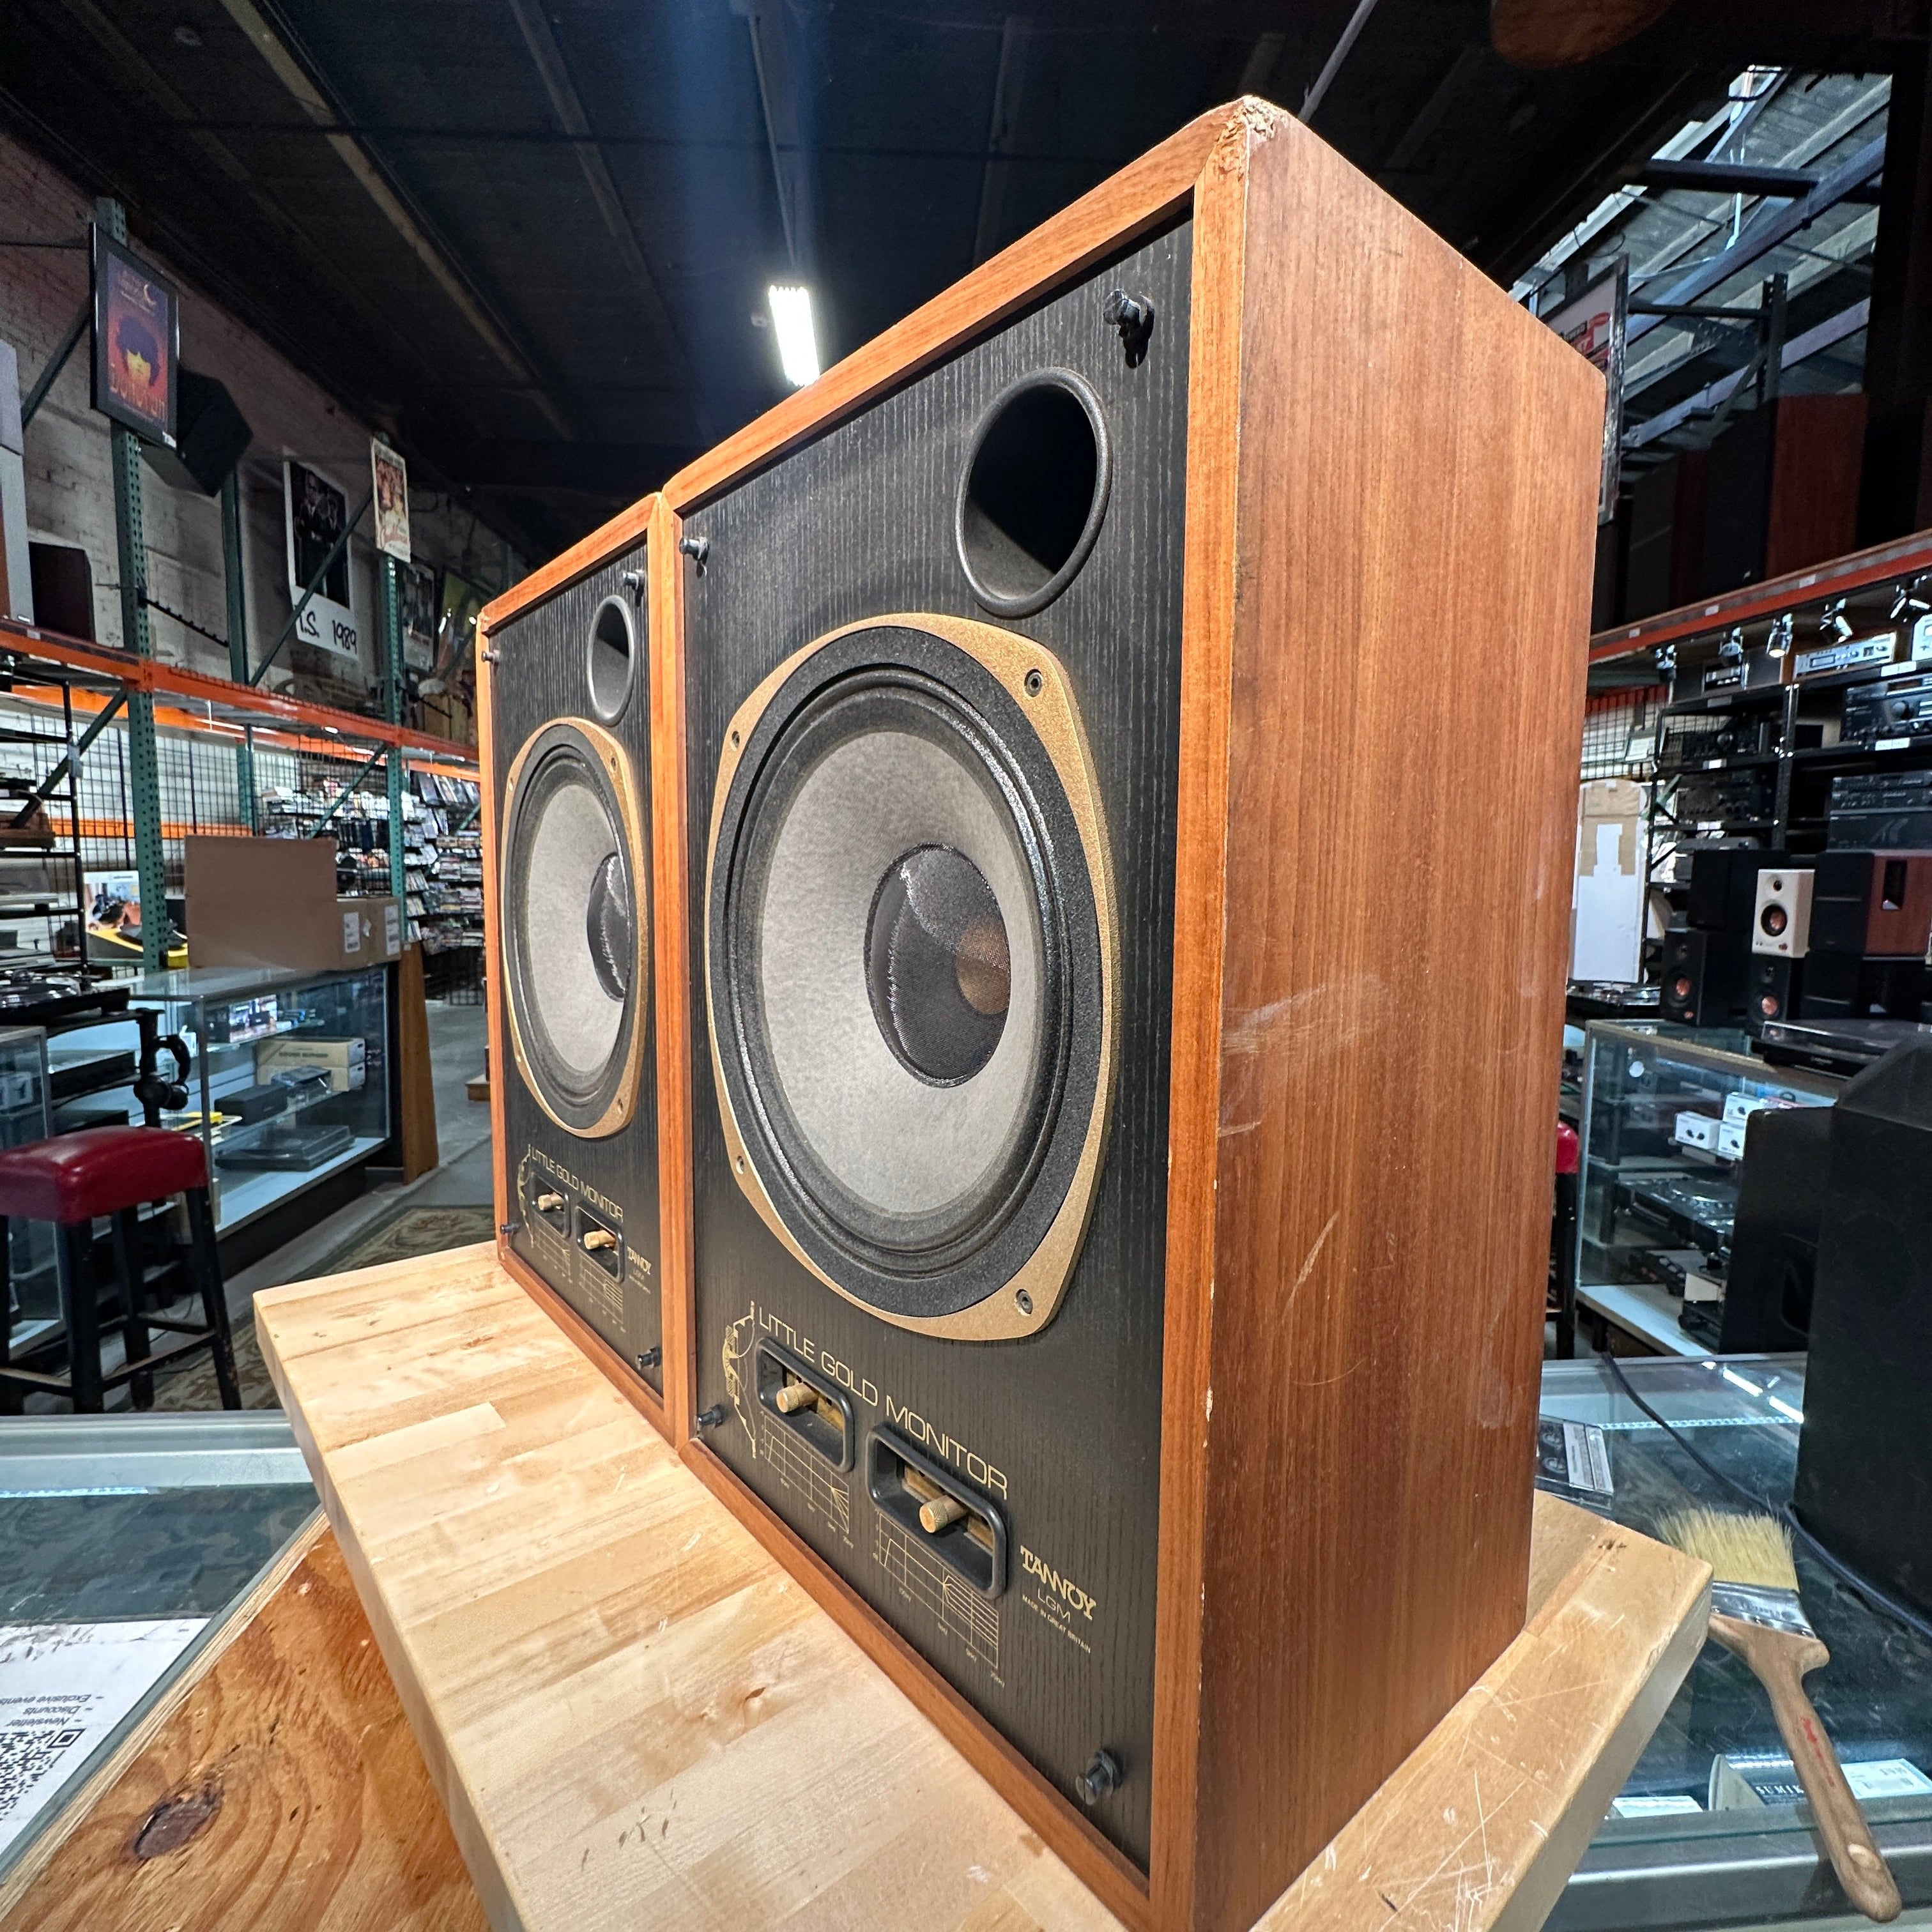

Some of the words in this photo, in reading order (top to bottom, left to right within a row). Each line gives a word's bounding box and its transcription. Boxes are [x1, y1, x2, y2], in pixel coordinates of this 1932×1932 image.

[332, 620, 356, 654] 1989
[532, 1147, 555, 1174] LITTLE
[556, 1165, 579, 1190] GOLD
[580, 1181, 624, 1223] MONITOR
[758, 1306, 815, 1363] LITTLE
[821, 1351, 878, 1407] GOLD
[886, 1395, 1008, 1501] MONITOR
[1020, 1545, 1097, 1621] TANNOY
[1022, 1594, 1038, 1612] MADE
[1040, 1609, 1046, 1619] IN
[1047, 1614, 1066, 1636] GREAT
[1067, 1630, 1091, 1654] BRITAIN
[1038, 1588, 1071, 1624] LGM
[23, 1705, 82, 1715] Discounts
[36, 1693, 92, 1703] Exclusive
[6, 1717, 71, 1727] Newsletter
